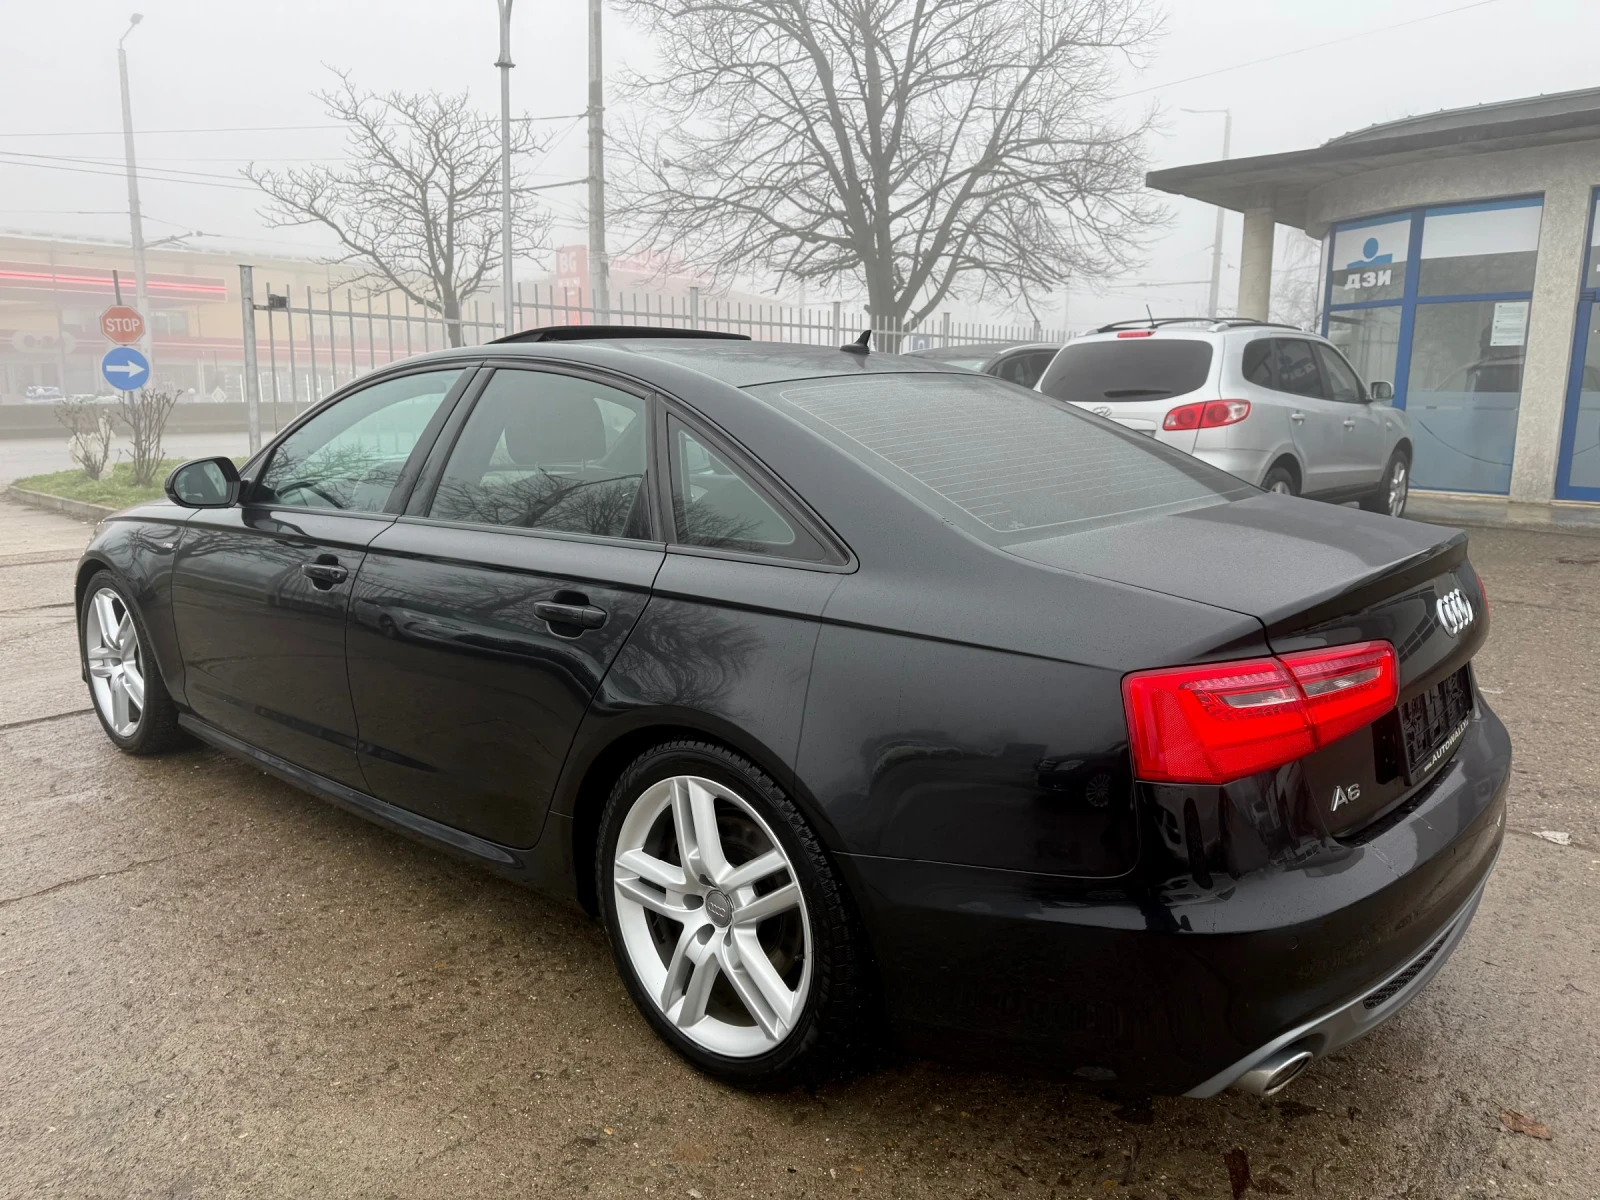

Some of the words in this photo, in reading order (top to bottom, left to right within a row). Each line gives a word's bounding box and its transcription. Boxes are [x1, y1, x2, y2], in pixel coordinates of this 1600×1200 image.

[1344, 269, 1392, 291] ДЗИ
[106, 318, 140, 332] STOP
[1331, 783, 1360, 812] A6
